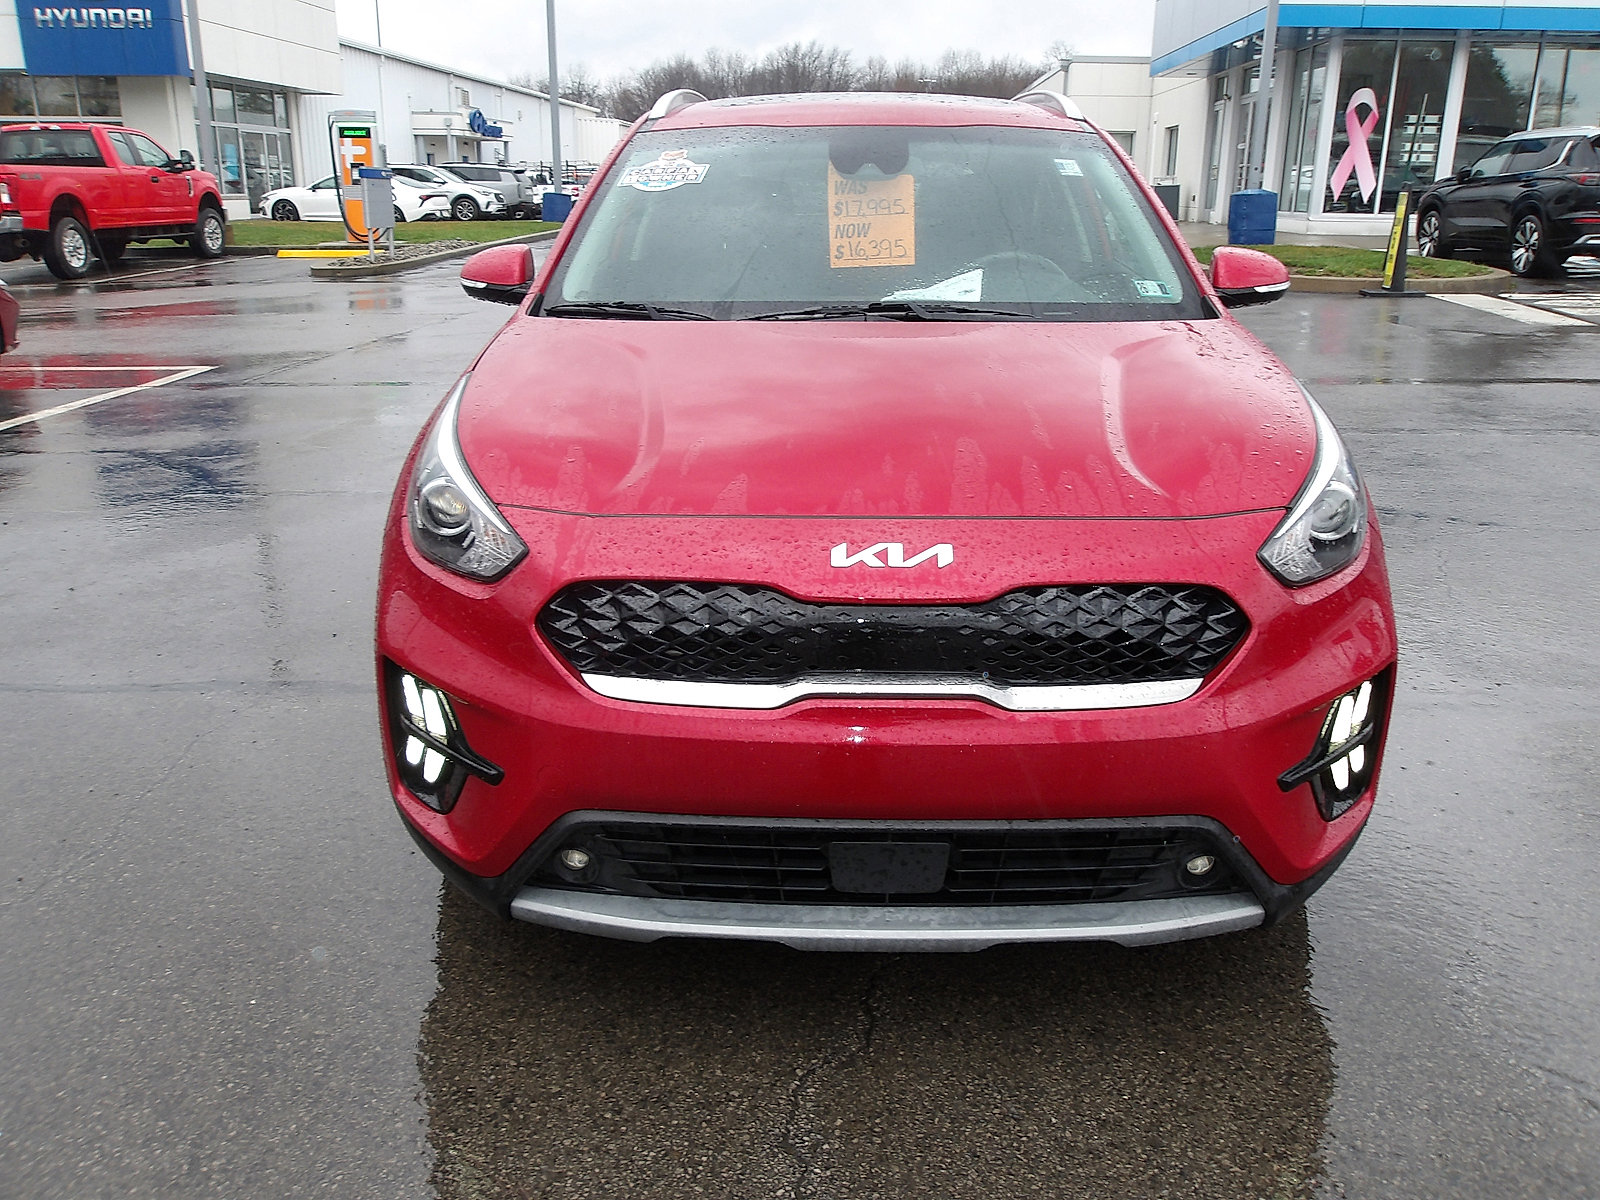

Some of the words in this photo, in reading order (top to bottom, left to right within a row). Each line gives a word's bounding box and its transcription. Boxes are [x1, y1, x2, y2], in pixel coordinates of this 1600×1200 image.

[33, 7, 153, 29] HYUNDAI
[834, 180, 868, 195] WAS
[833, 199, 906, 217] $17,995
[834, 223, 872, 239] NOW
[834, 239, 907, 260] $16,395
[830, 541, 954, 569] KIA
